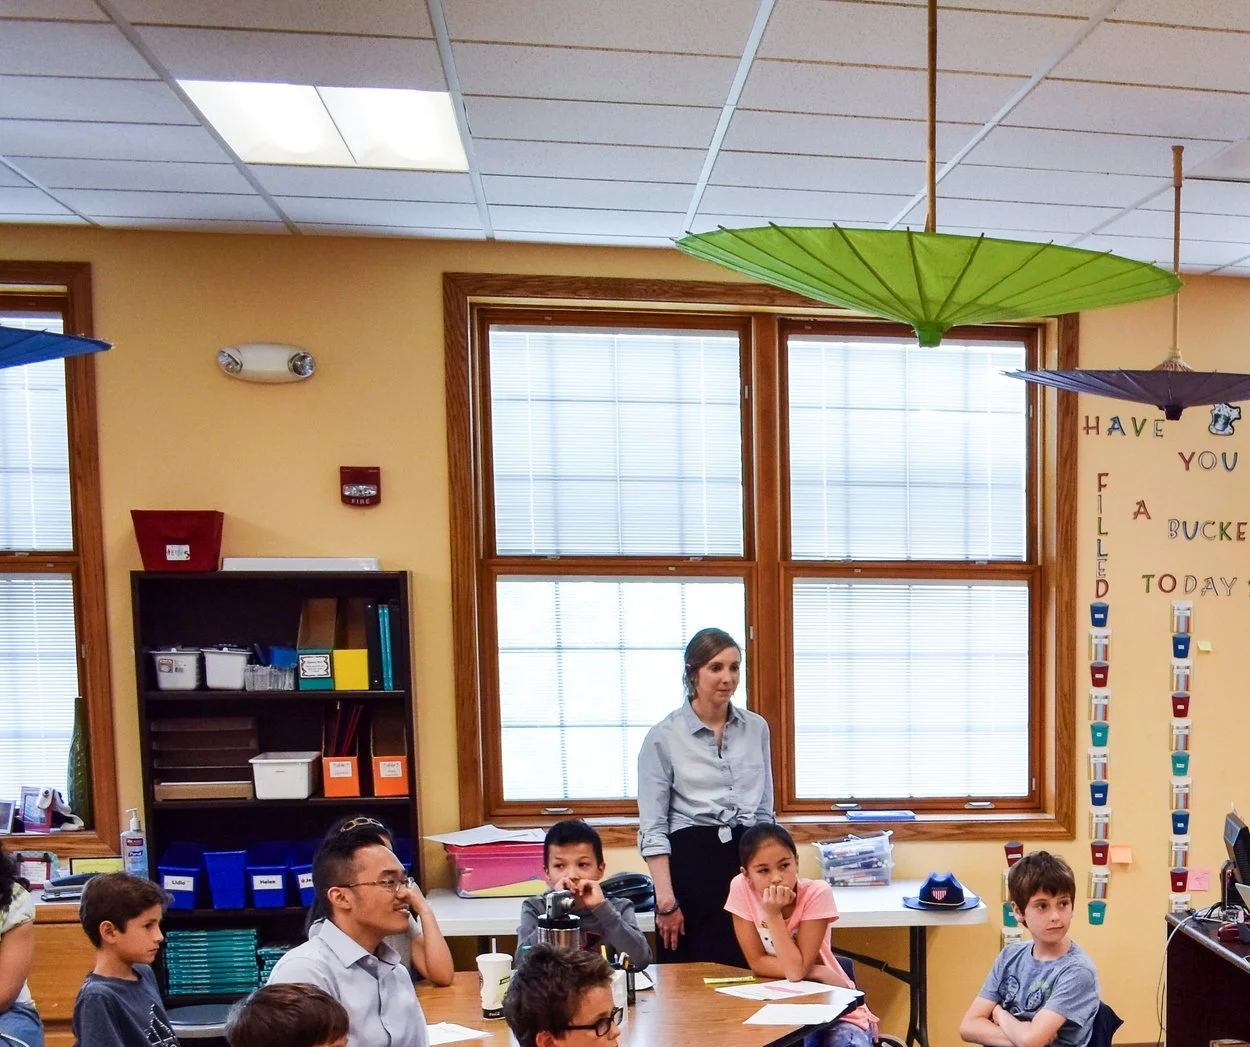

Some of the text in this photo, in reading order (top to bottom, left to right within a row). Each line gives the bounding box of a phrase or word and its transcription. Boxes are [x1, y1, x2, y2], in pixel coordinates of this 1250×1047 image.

[1083, 416, 1165, 438] HAVE
[1178, 451, 1239, 472] YOU
[1133, 500, 1152, 521] A
[1094, 473, 1110, 599] FILLED
